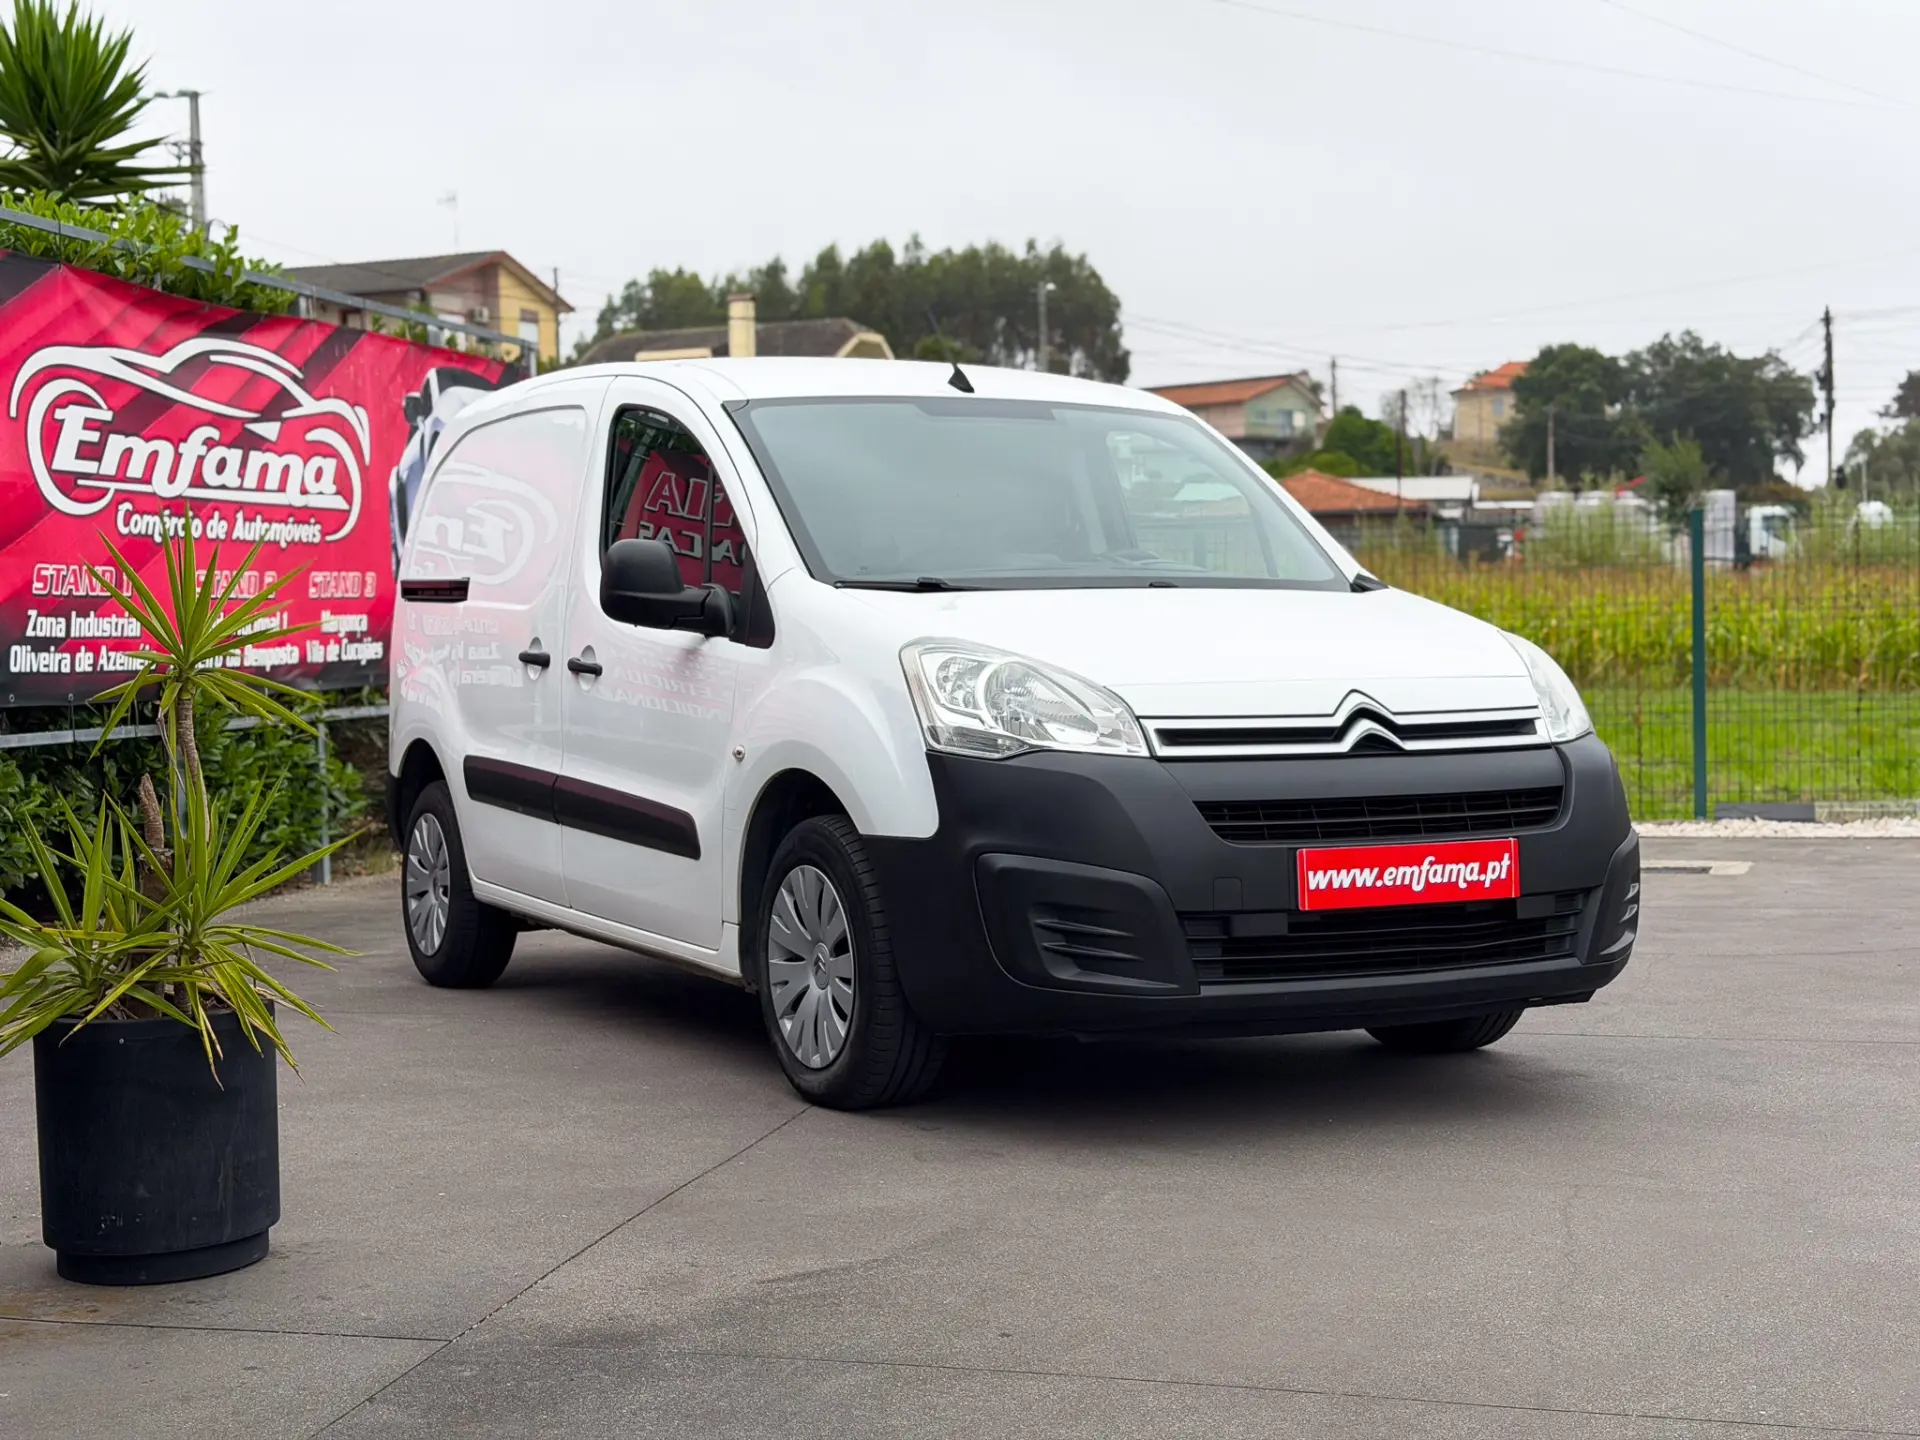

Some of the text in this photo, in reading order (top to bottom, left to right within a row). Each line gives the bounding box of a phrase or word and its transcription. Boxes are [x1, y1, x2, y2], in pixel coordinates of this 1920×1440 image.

[52, 404, 339, 508] Emfama
[116, 501, 322, 549] Comérco de Automóveis
[32, 563, 133, 597] STAND 1
[308, 571, 377, 599] STAND 3
[25, 609, 142, 638] Zona Industrial
[10, 643, 157, 674] Oliveira de Azemé
[1307, 852, 1511, 892] www.emfama.pt
